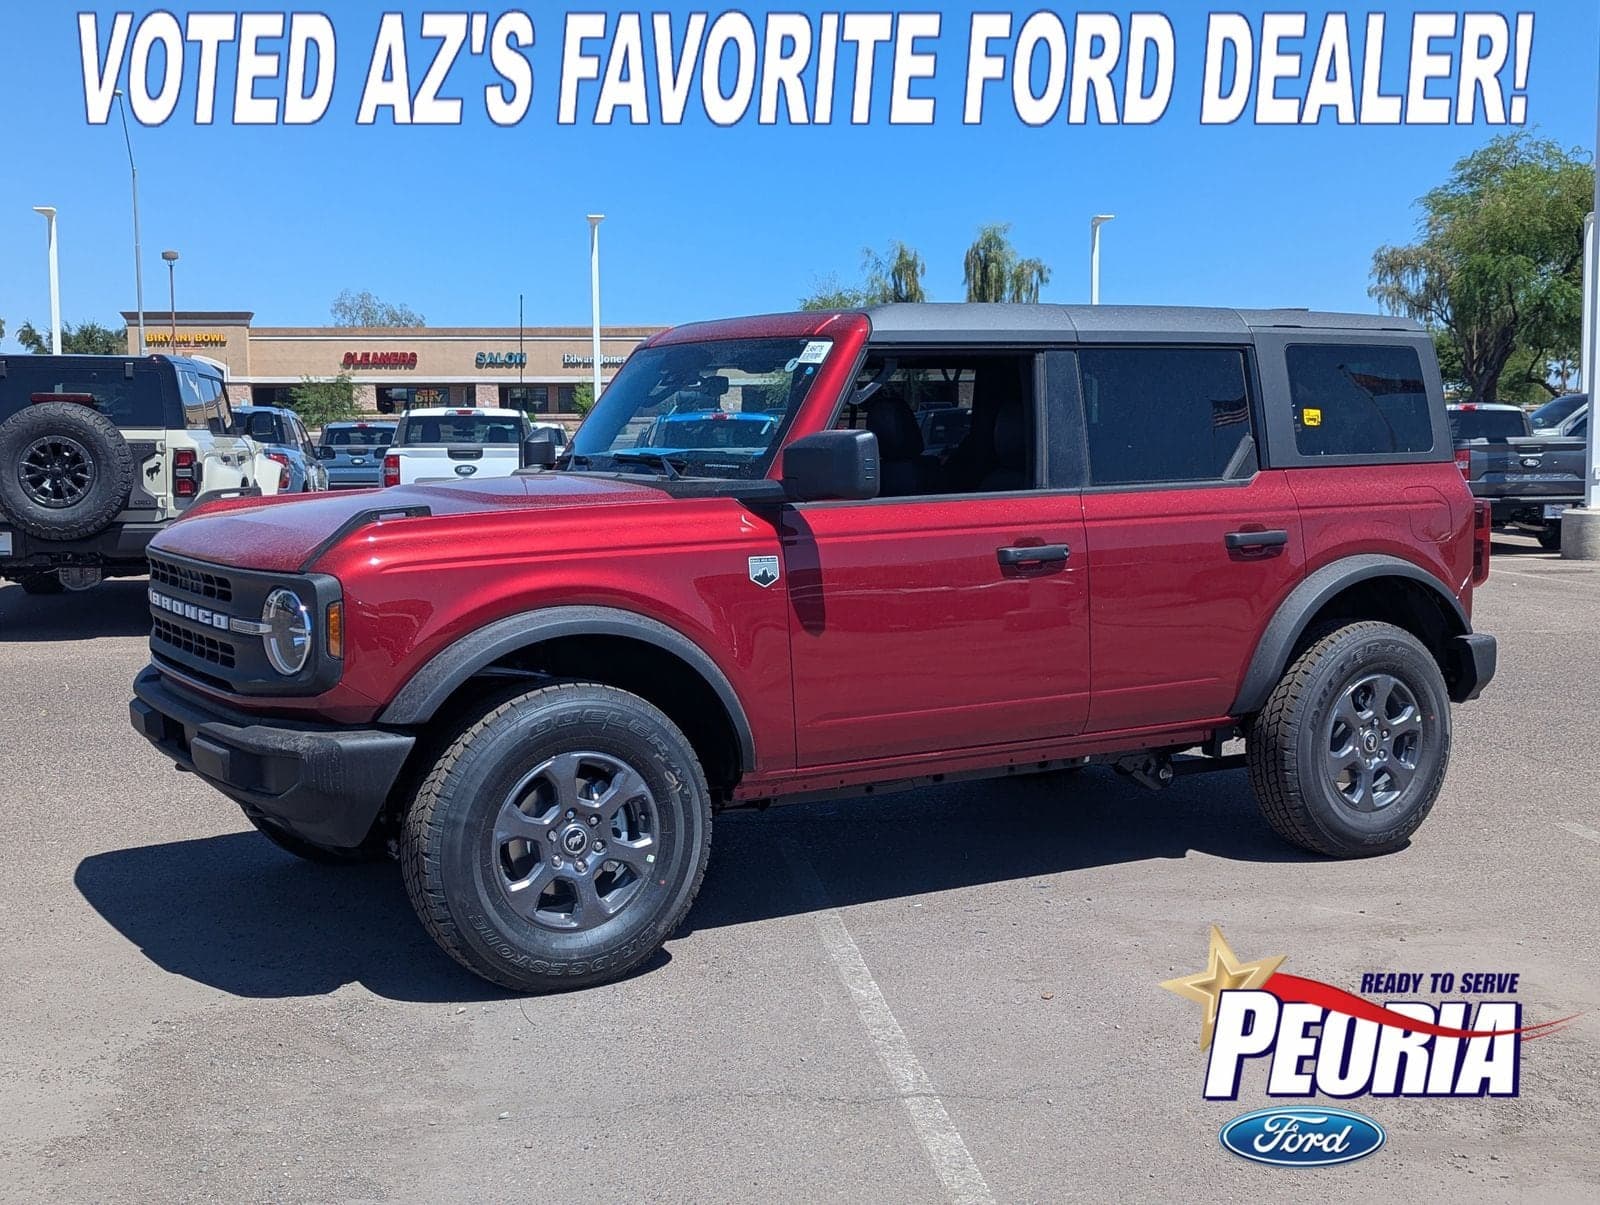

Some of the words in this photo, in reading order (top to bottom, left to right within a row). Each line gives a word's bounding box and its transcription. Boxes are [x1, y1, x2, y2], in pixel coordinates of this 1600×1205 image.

[145, 332, 191, 342] BIRYANI
[194, 332, 227, 342] BOWL
[344, 352, 418, 365] CLEANERS
[476, 352, 528, 365] SALON
[563, 353, 596, 364] Edwar
[151, 590, 229, 630] BRONCO
